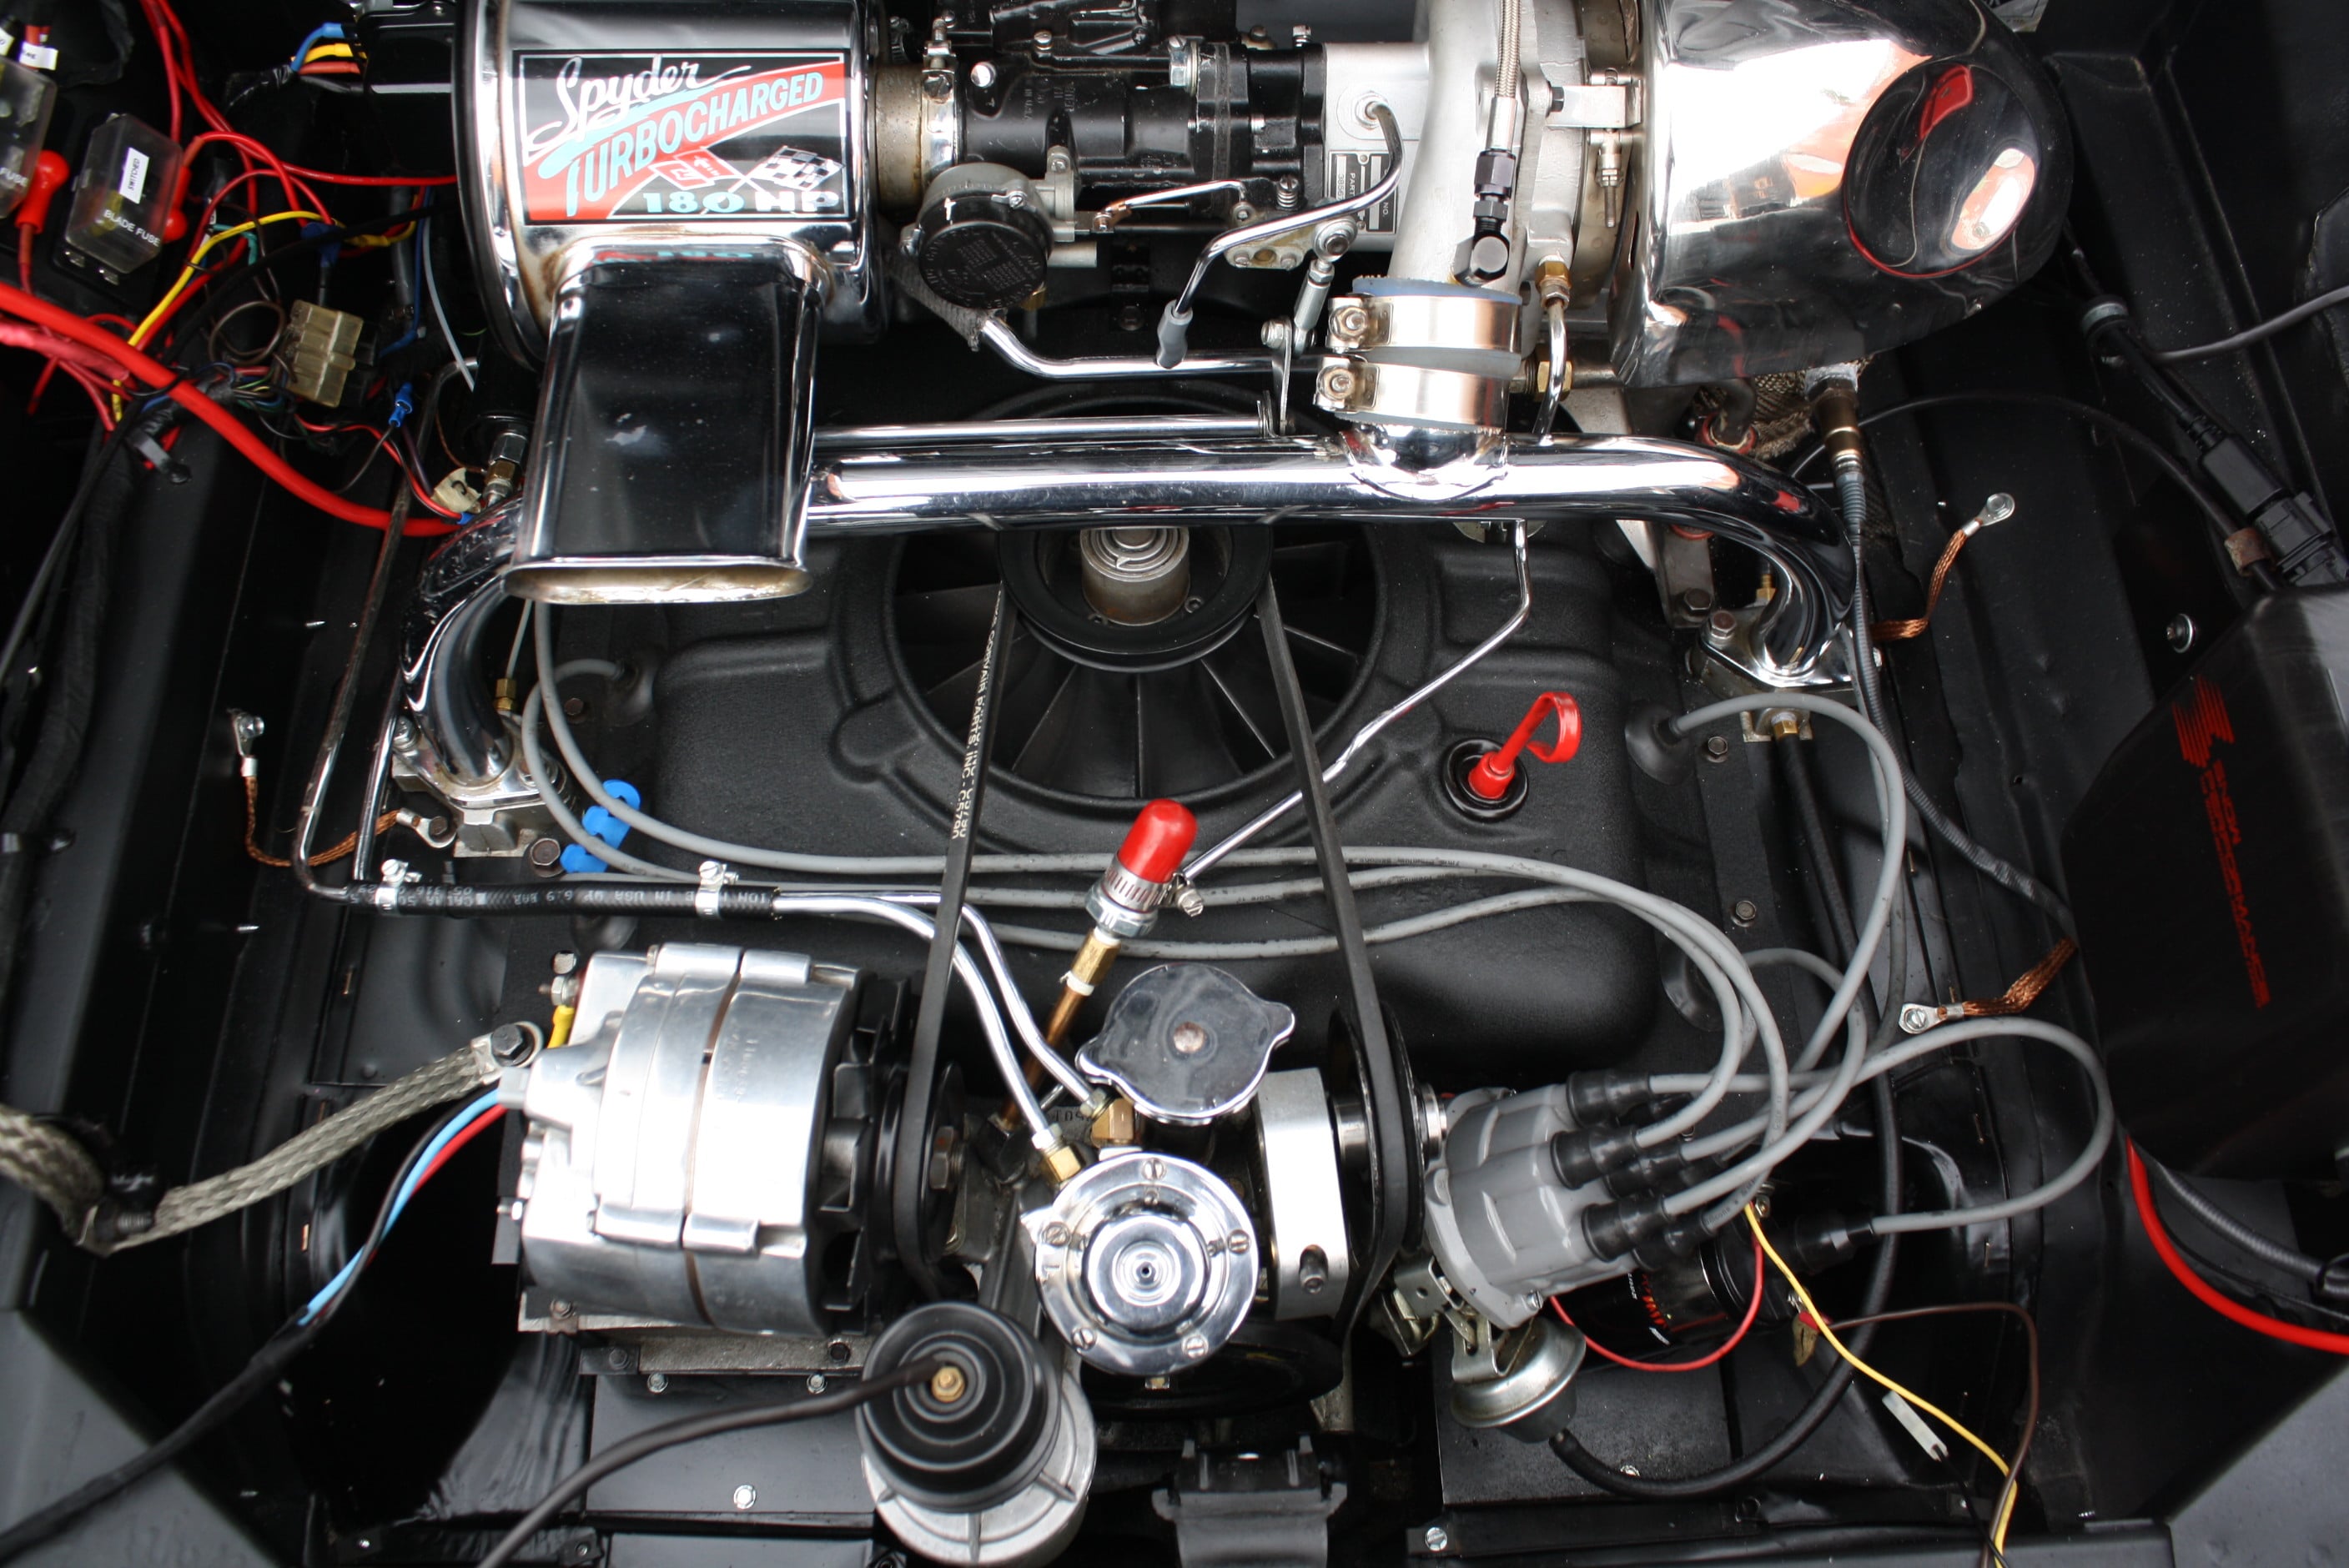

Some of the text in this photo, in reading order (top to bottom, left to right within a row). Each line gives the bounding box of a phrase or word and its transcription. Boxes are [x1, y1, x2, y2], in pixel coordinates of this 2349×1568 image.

[527, 54, 752, 154] Spyder
[537, 72, 824, 217] TURBOCHARGED
[128, 157, 141, 192] SWITCHED
[643, 190, 840, 214] 180 HP
[103, 209, 162, 248] BLADE FUSE
